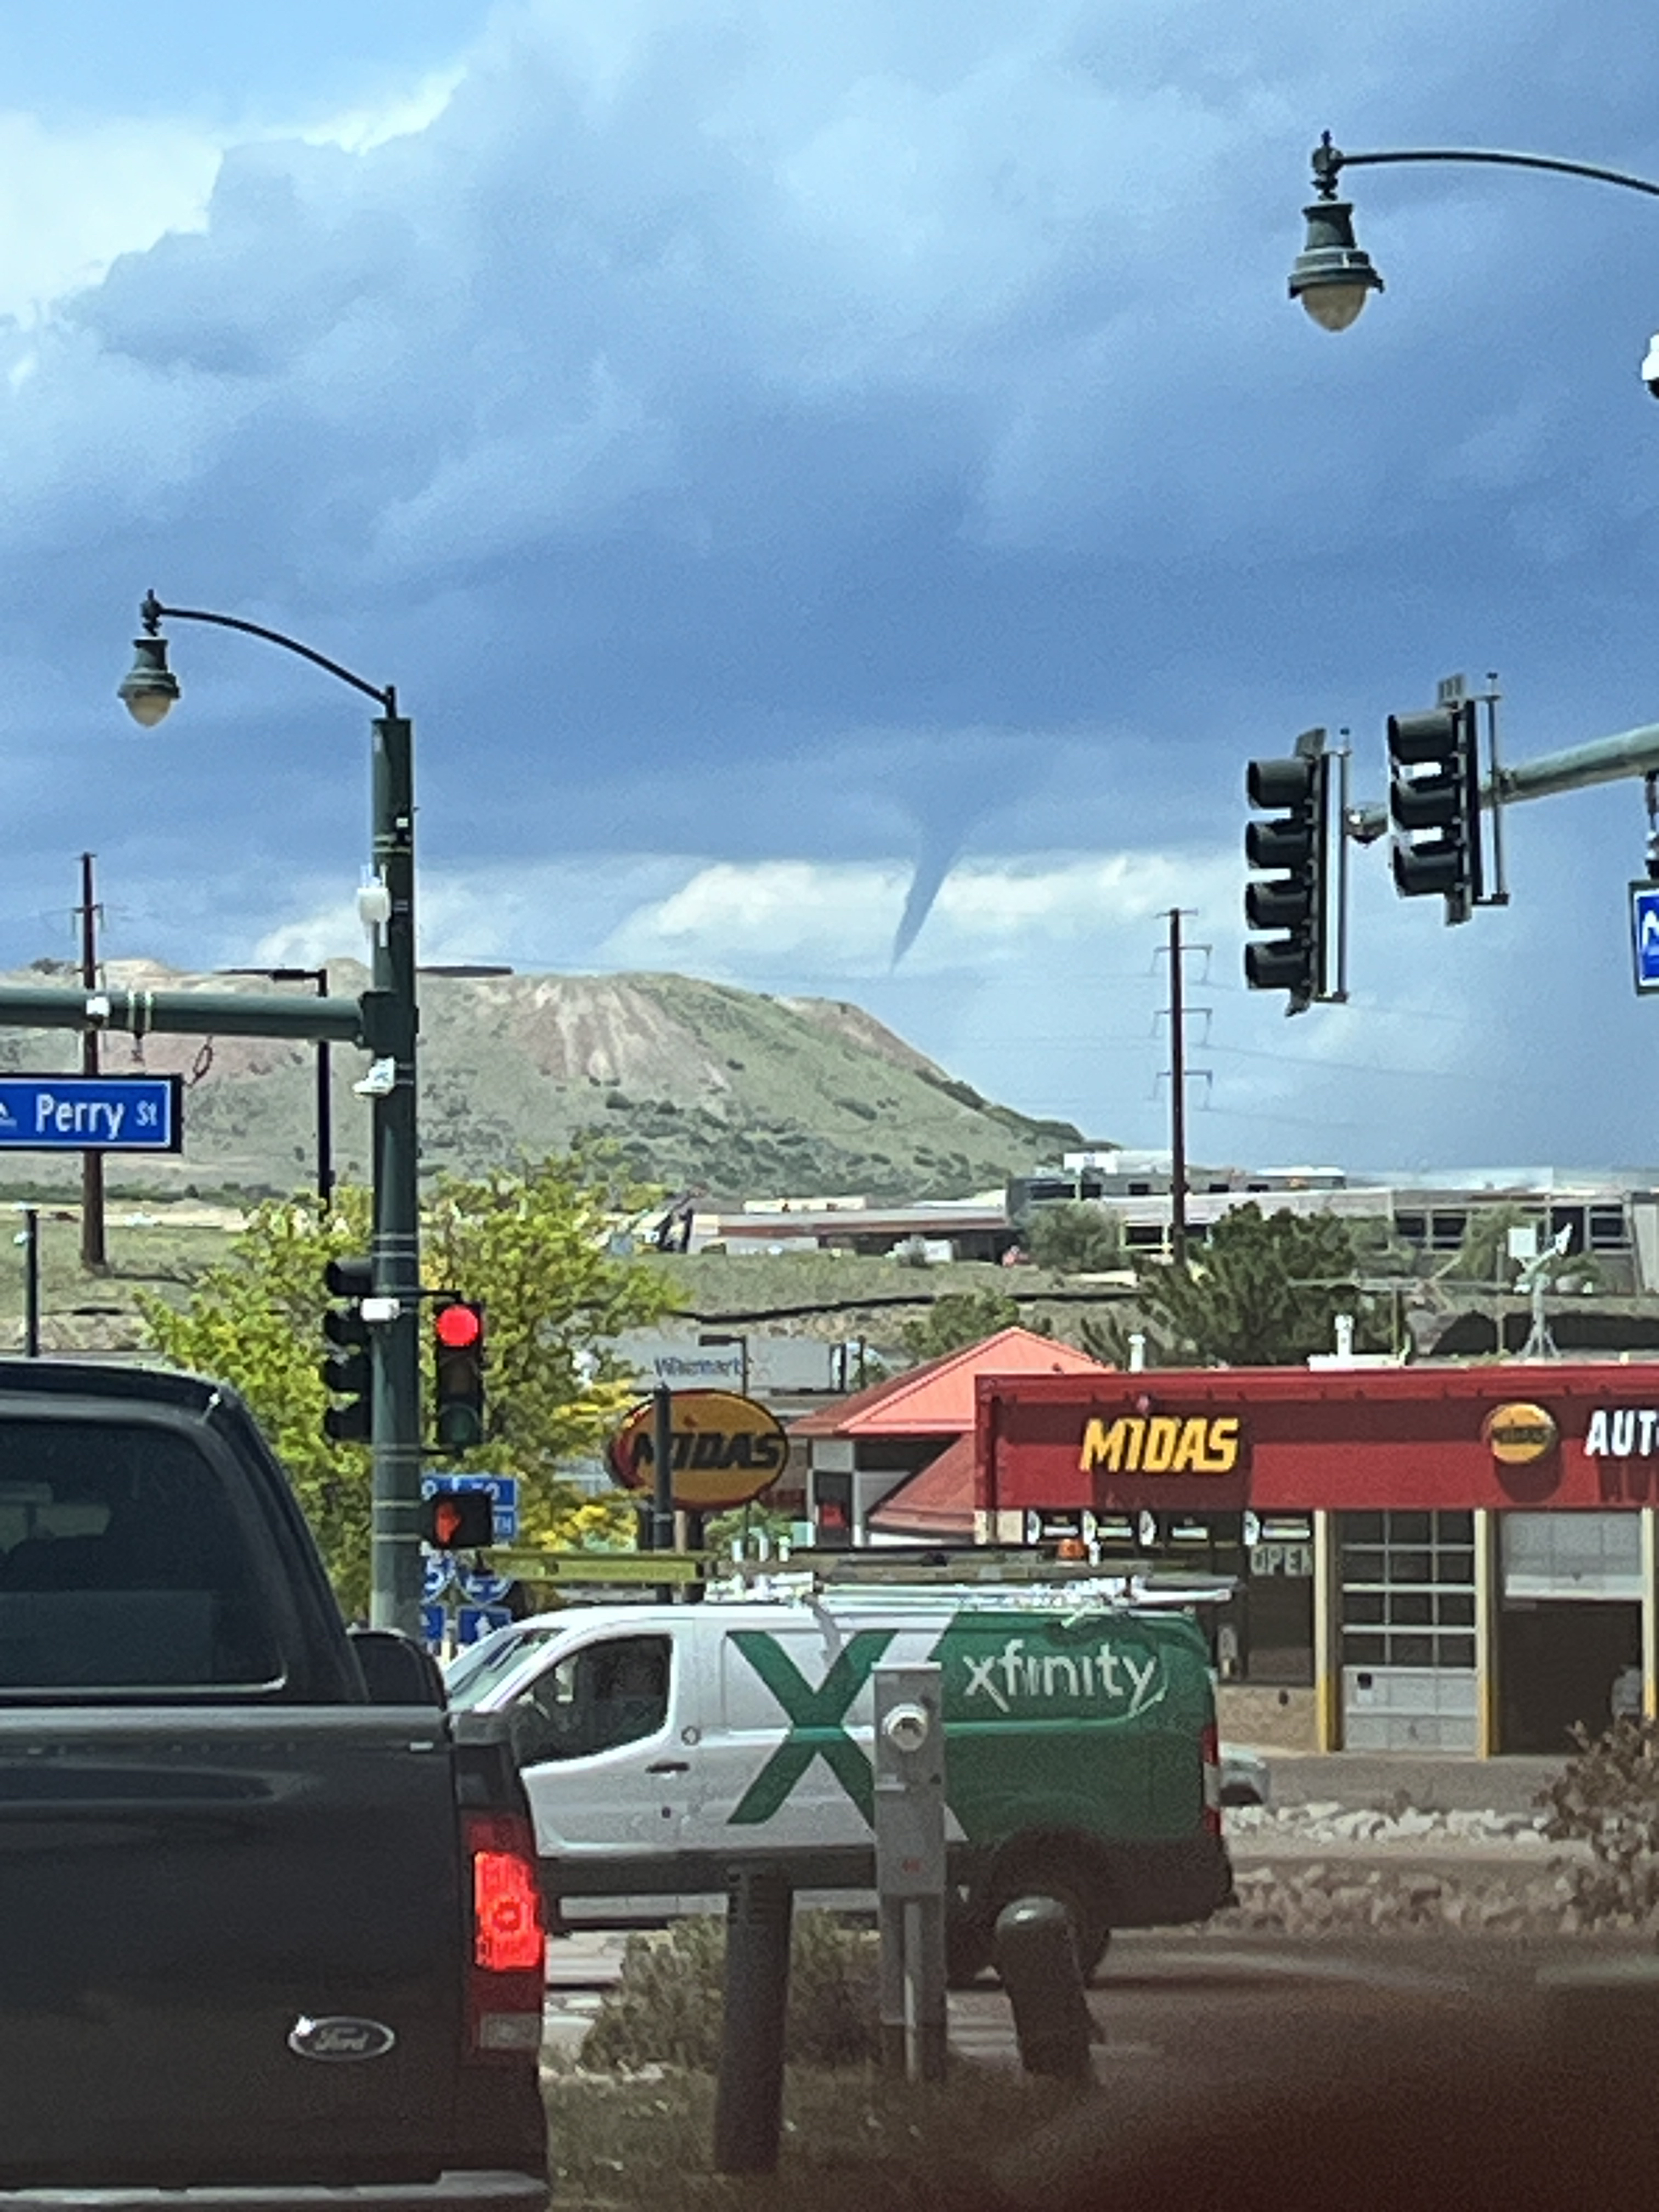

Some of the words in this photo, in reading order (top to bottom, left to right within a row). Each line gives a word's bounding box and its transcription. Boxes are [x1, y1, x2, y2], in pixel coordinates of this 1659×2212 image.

[35, 1093, 125, 1139] Perry
[136, 1101, 157, 1127] St
[1079, 1418, 1240, 1472] MIDAS
[1583, 1410, 1659, 1456] AUT
[962, 1639, 1158, 1717] xfinity
[315, 2027, 369, 2051] Ford
